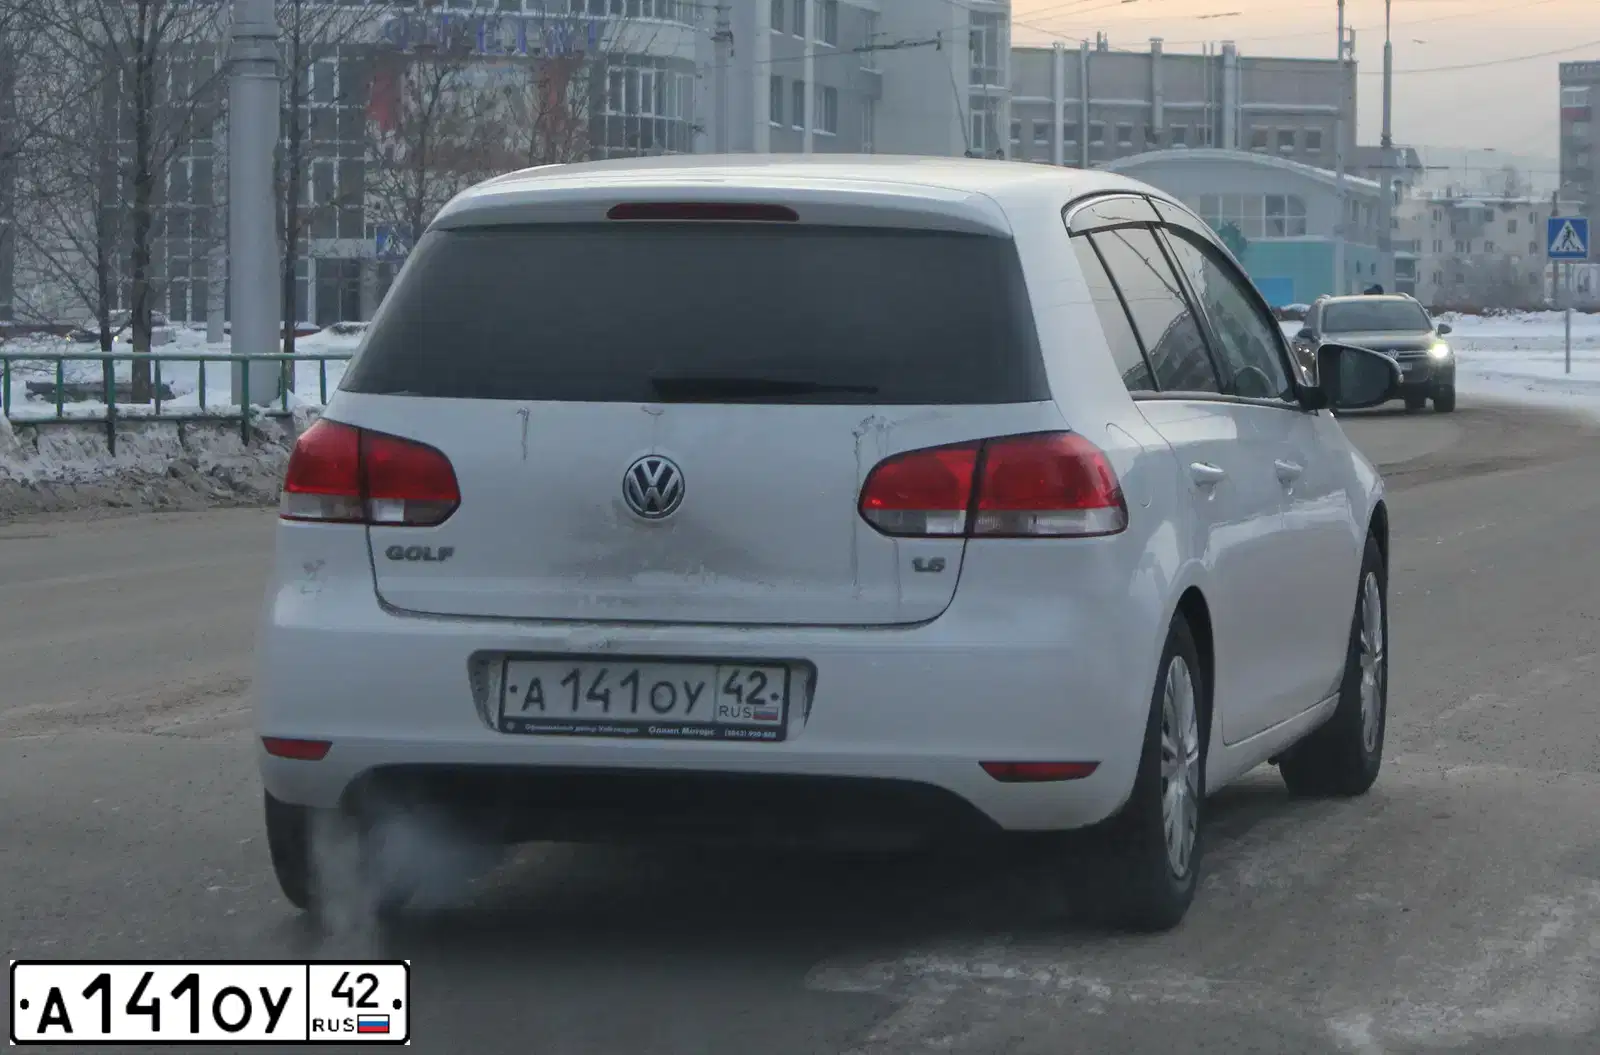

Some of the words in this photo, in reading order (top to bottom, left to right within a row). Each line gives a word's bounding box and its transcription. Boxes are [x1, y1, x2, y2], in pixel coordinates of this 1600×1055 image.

[385, 545, 455, 562] GOLF
[723, 668, 768, 704] 42
[719, 705, 752, 718] RUS
